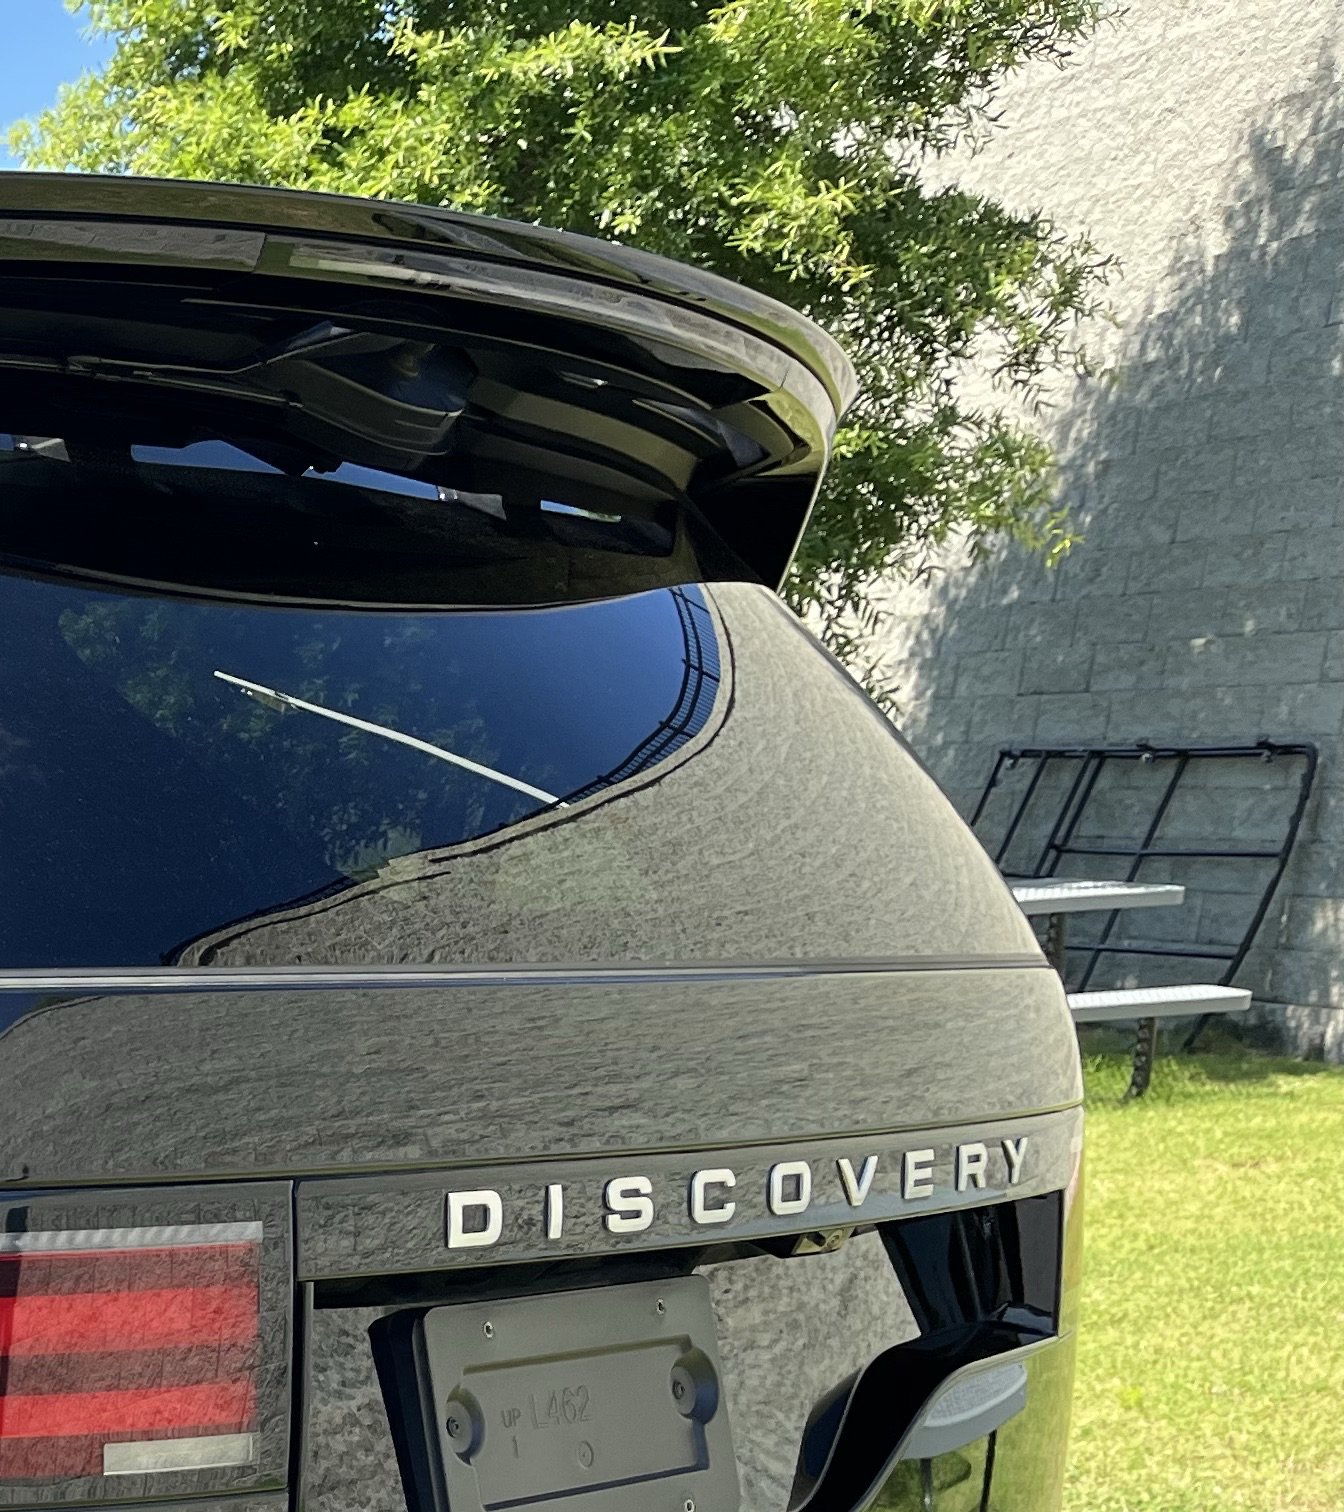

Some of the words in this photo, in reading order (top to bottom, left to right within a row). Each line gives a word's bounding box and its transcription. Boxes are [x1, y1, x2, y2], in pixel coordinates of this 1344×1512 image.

[447, 1138, 1028, 1249] DISCOVERY
[501, 1407, 522, 1429] UP
[529, 1384, 593, 1430] L462
